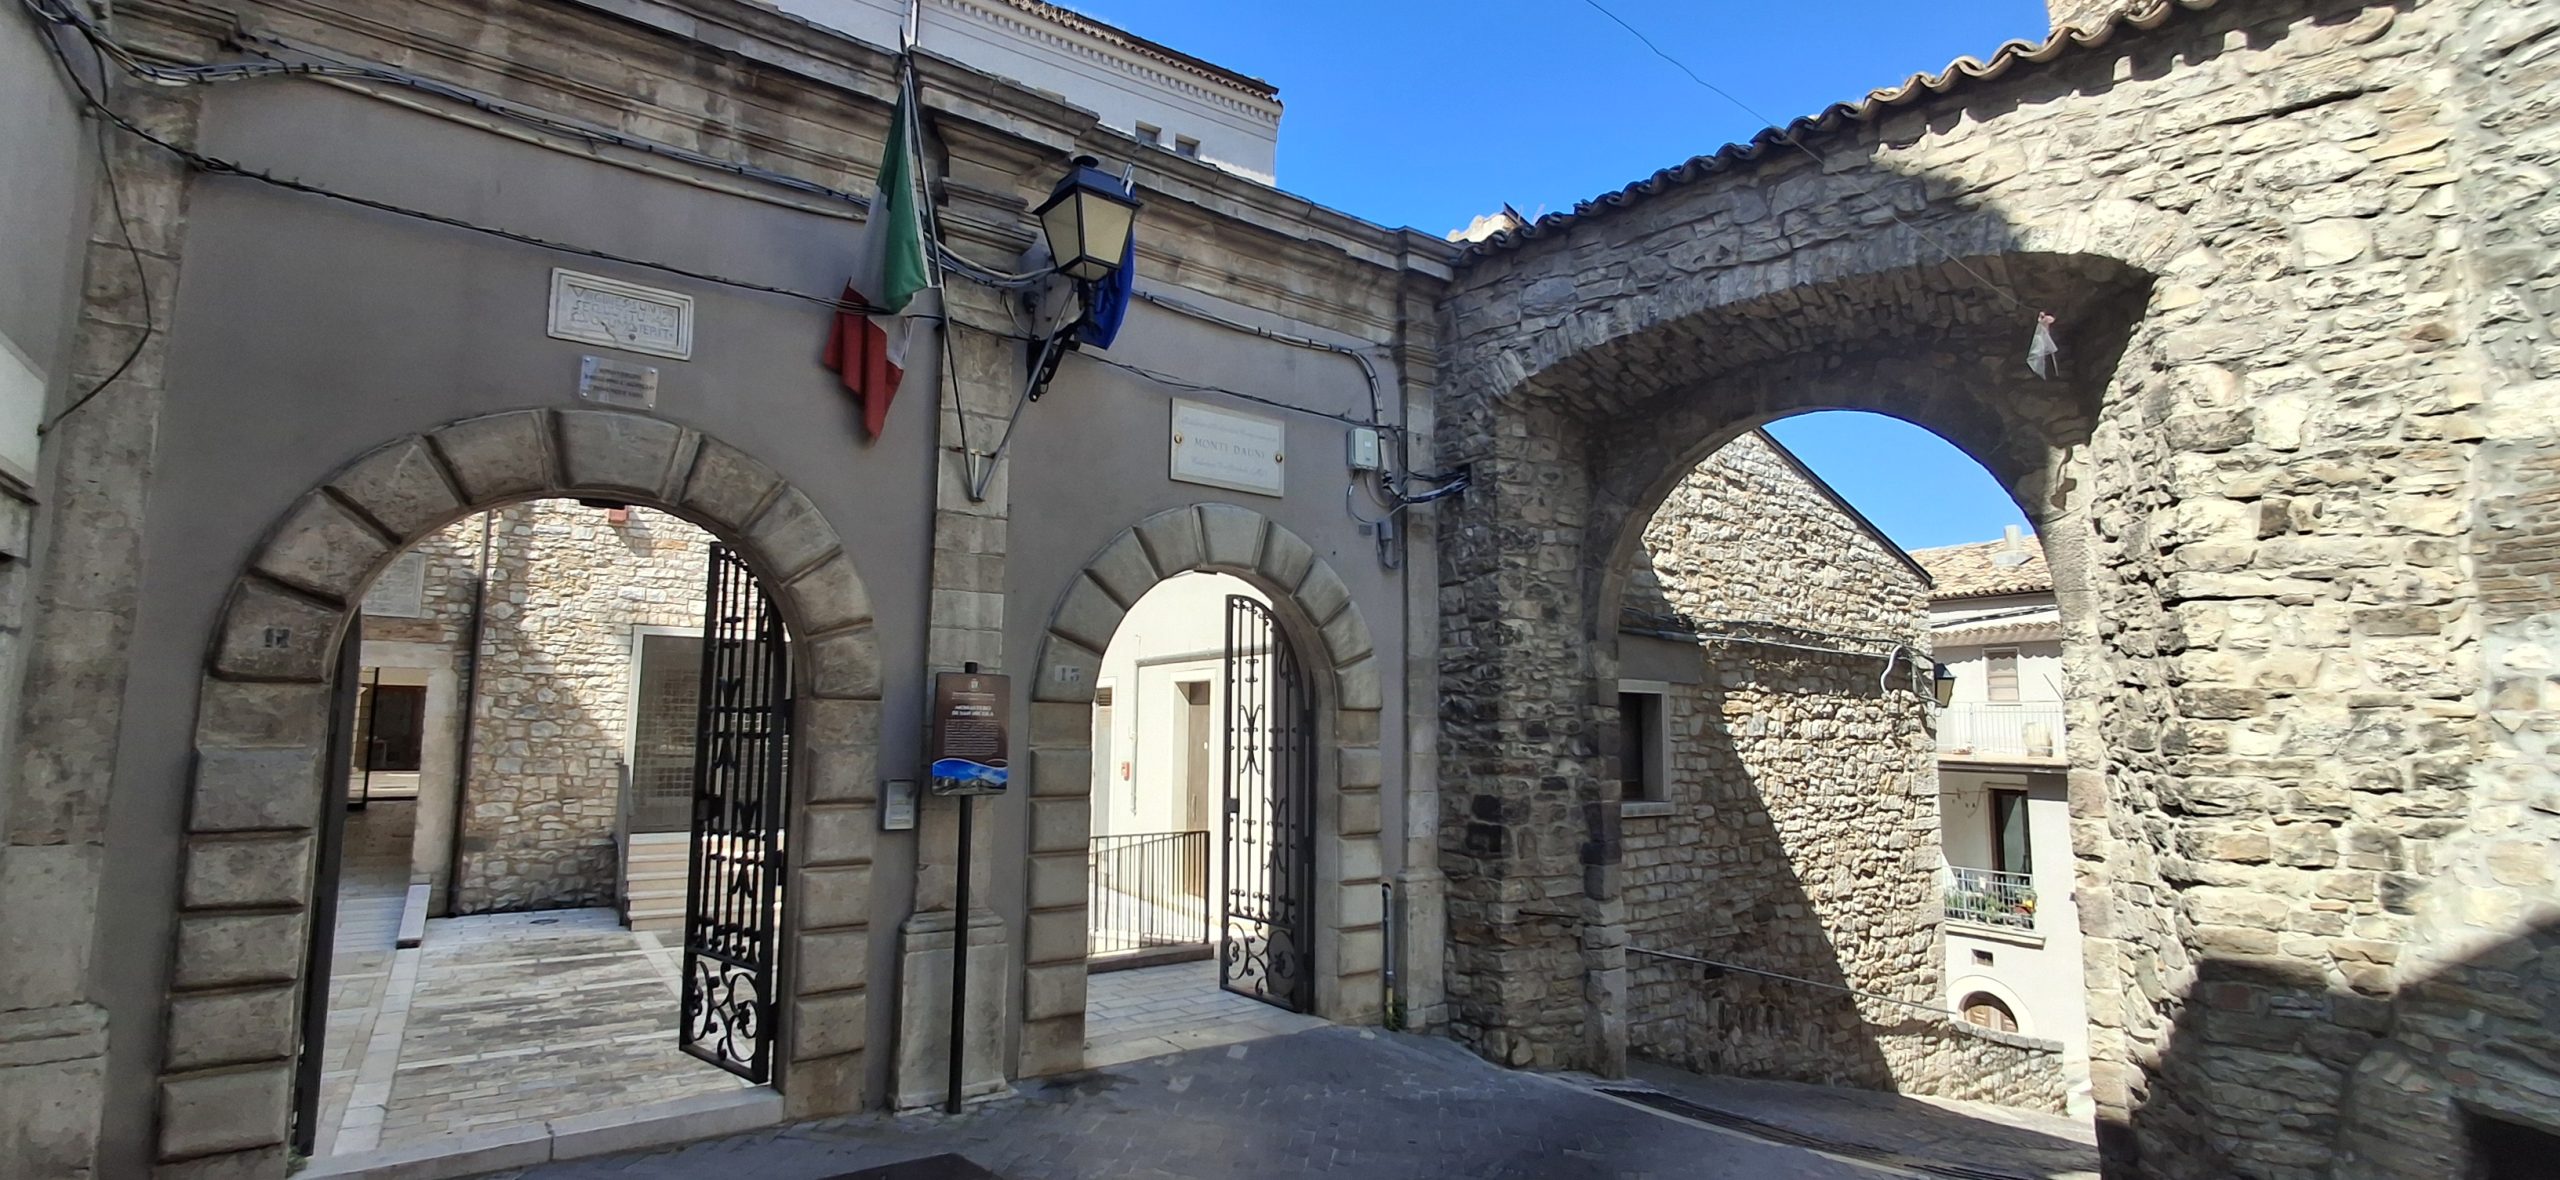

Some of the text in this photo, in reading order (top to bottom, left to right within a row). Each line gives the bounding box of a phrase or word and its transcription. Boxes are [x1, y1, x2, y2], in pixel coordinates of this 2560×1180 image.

[1194, 437, 1265, 458] MONTI DAUNI
[1060, 666, 1081, 682] 15
